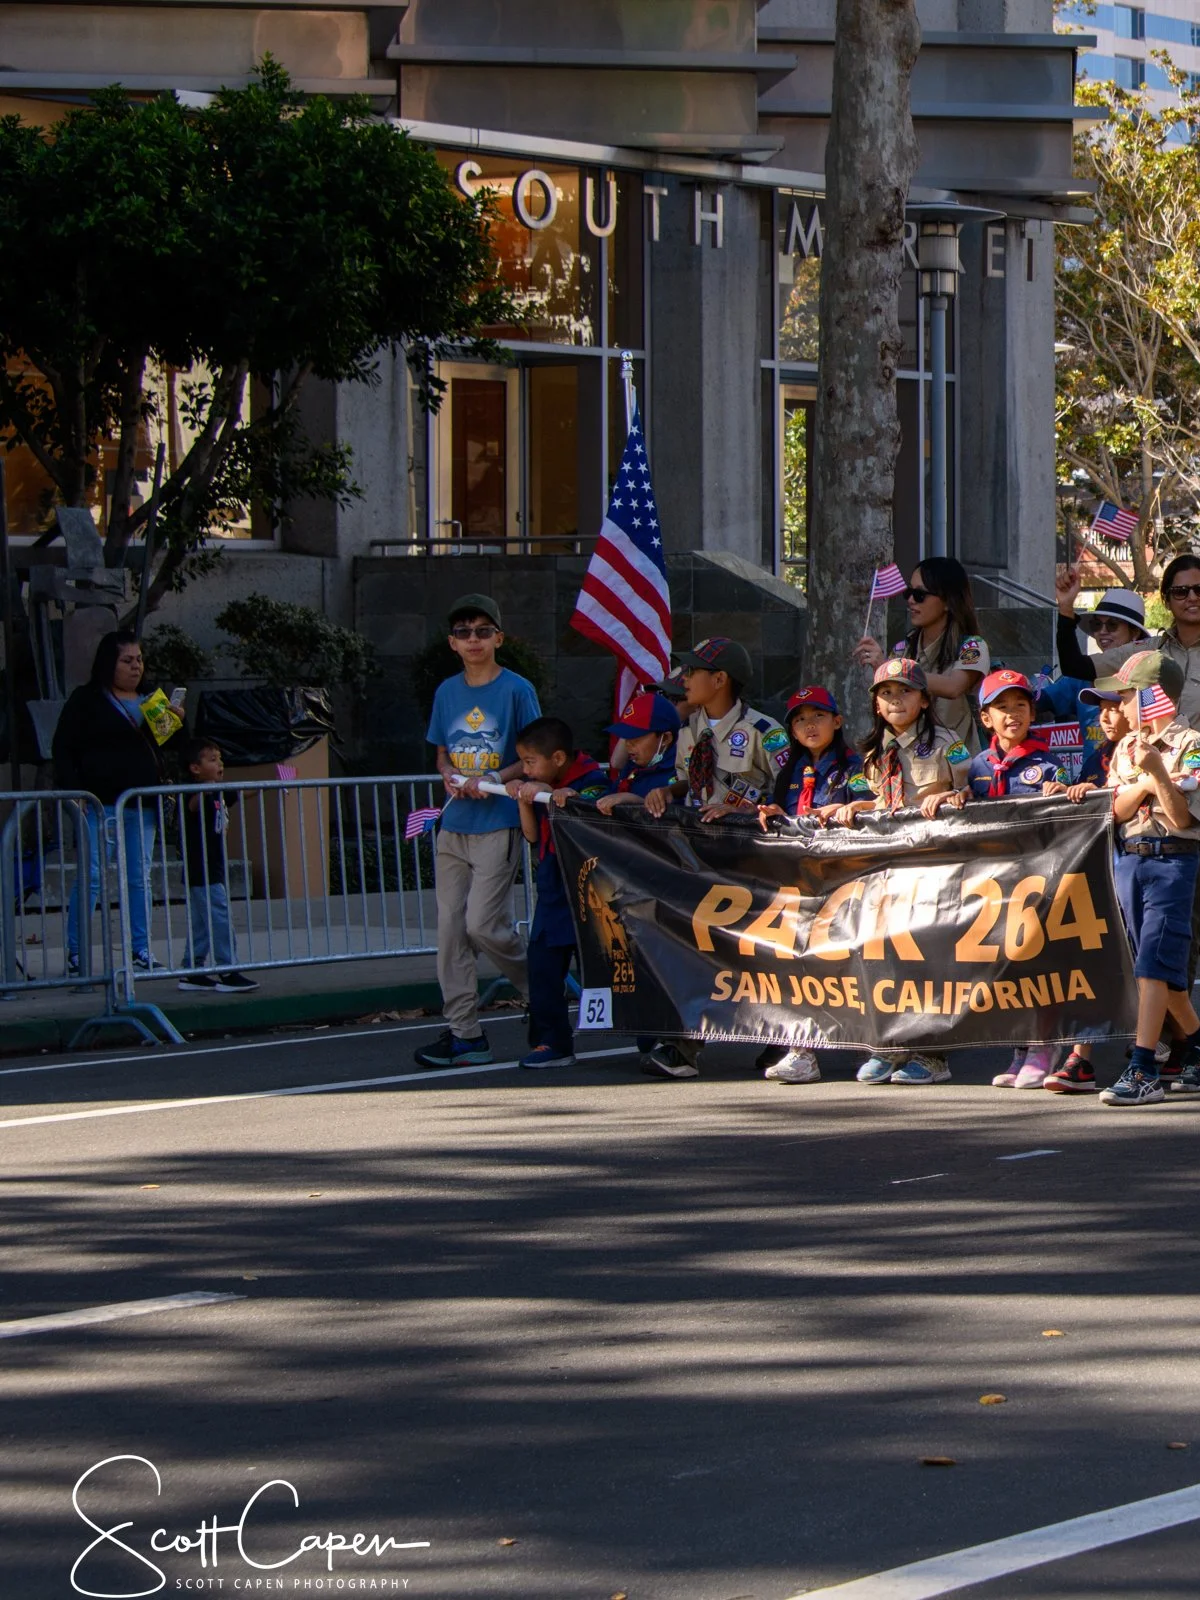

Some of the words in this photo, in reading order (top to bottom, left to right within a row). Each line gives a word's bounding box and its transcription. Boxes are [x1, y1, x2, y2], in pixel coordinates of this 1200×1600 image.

[455, 160, 724, 248] SOUTH
[784, 200, 1043, 282] MRET
[1049, 728, 1080, 746] AWAY
[450, 751, 476, 769] ACK
[479, 751, 500, 770] 26
[776, 751, 790, 767] 26
[691, 883, 925, 962] PACK
[955, 872, 1108, 963] 264
[612, 961, 636, 983] 264
[710, 970, 782, 1004] SAN
[790, 974, 866, 1016] JOSE,
[873, 969, 1097, 1015] CALIFORNIA
[586, 998, 605, 1023] 52
